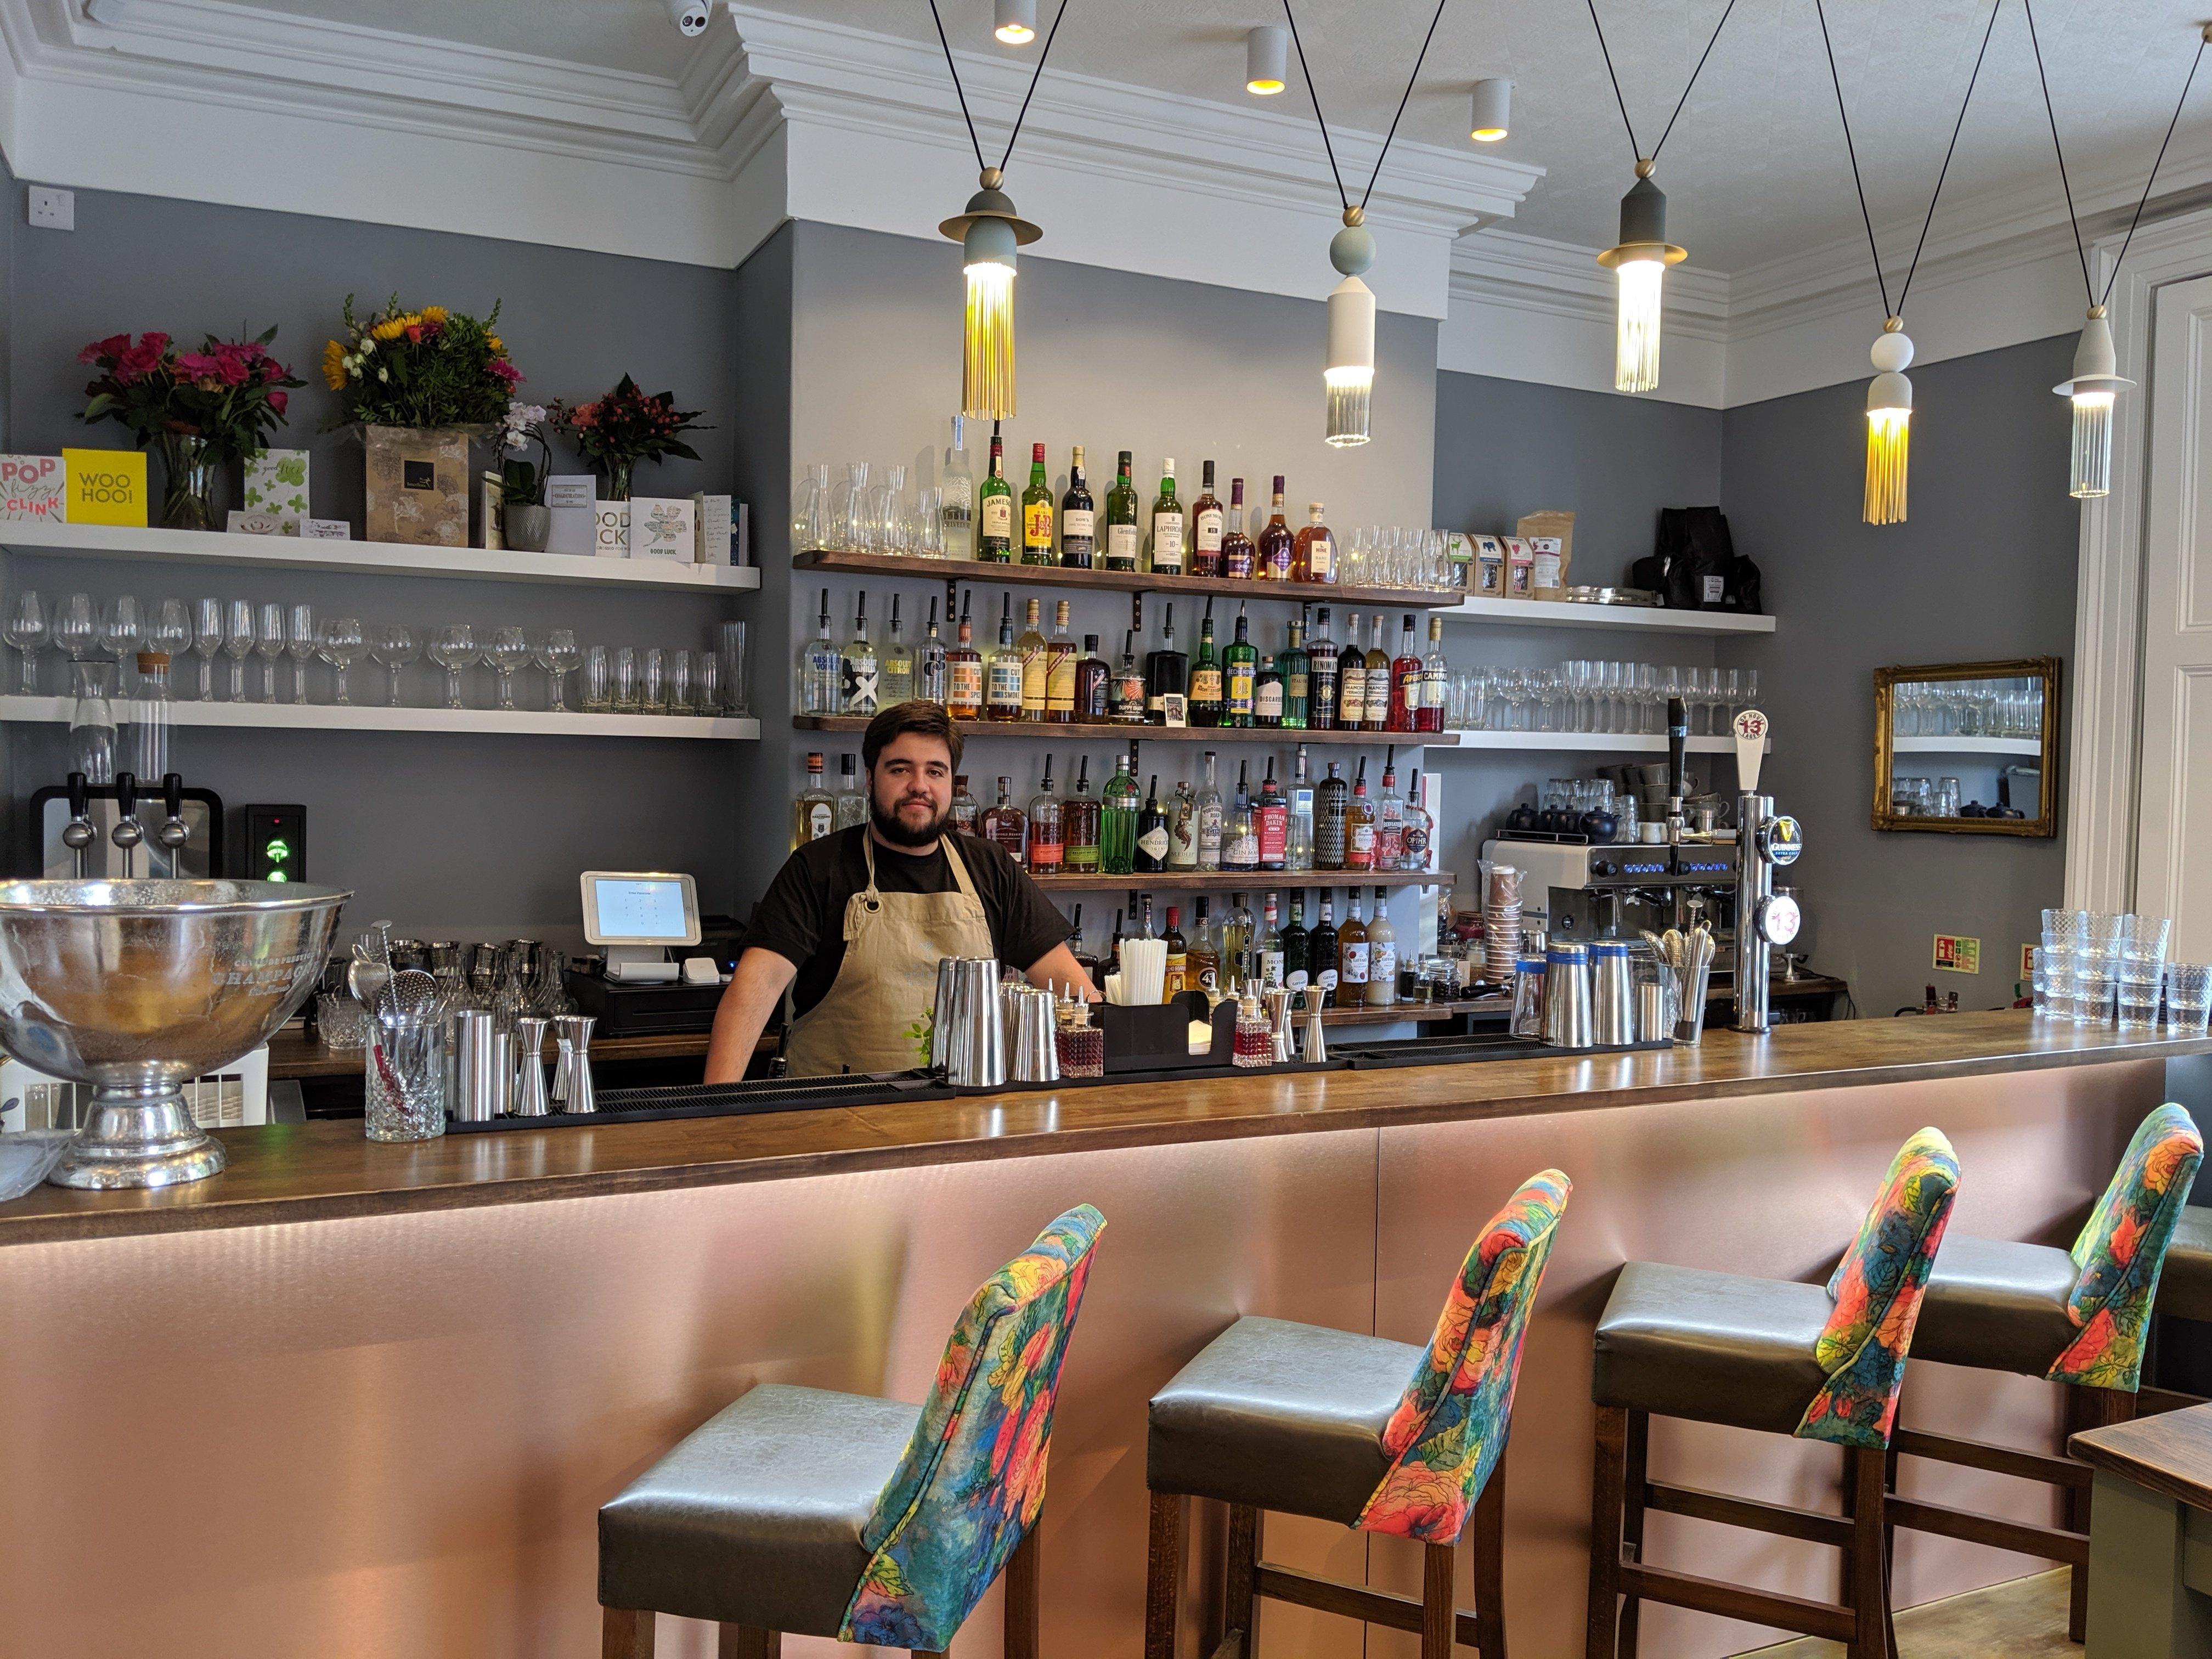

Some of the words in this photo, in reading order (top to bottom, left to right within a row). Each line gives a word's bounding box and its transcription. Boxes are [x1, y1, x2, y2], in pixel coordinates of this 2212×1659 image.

[2, 459, 55, 484] POP
[78, 472, 131, 488] WOO
[81, 488, 133, 504] HOO!
[7, 497, 59, 515] CLINK
[596, 511, 630, 528] OD
[596, 529, 627, 545] CK
[884, 659, 912, 667] ABSOLUT
[887, 666, 910, 674] CITRON
[1743, 720, 1762, 734] 13
[1407, 837, 1427, 845] OPIHR
[1771, 911, 1799, 933] 13
[212, 961, 320, 985] CHAMPAGNE
